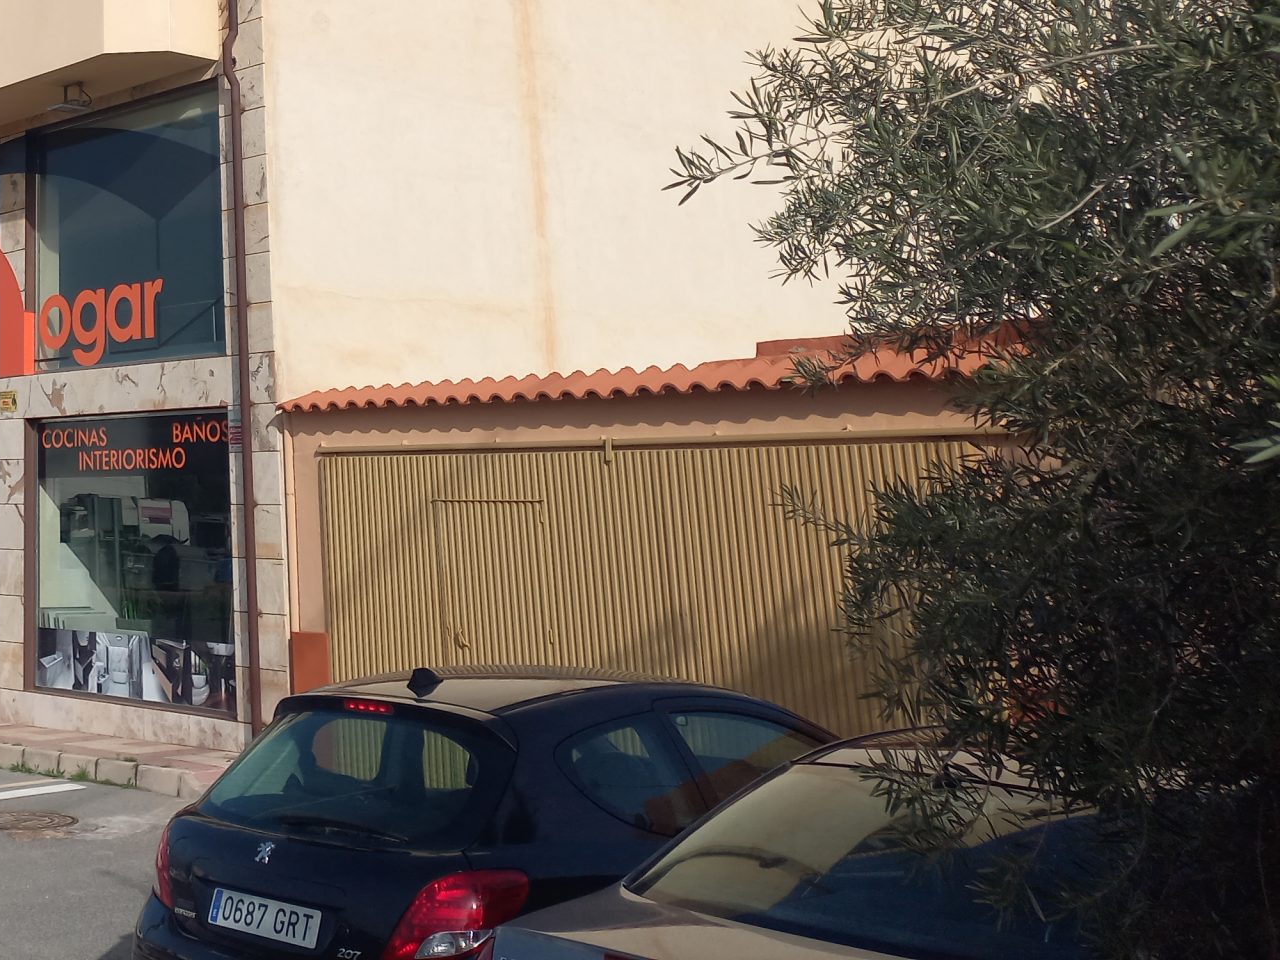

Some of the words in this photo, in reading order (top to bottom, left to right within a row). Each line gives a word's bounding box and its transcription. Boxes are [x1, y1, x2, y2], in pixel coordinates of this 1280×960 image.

[42, 426, 108, 449] COCINAS
[78, 447, 186, 472] INTERIORISMO
[221, 894, 269, 930] 0687
[273, 907, 314, 942] GRT
[336, 947, 363, 960] 207
